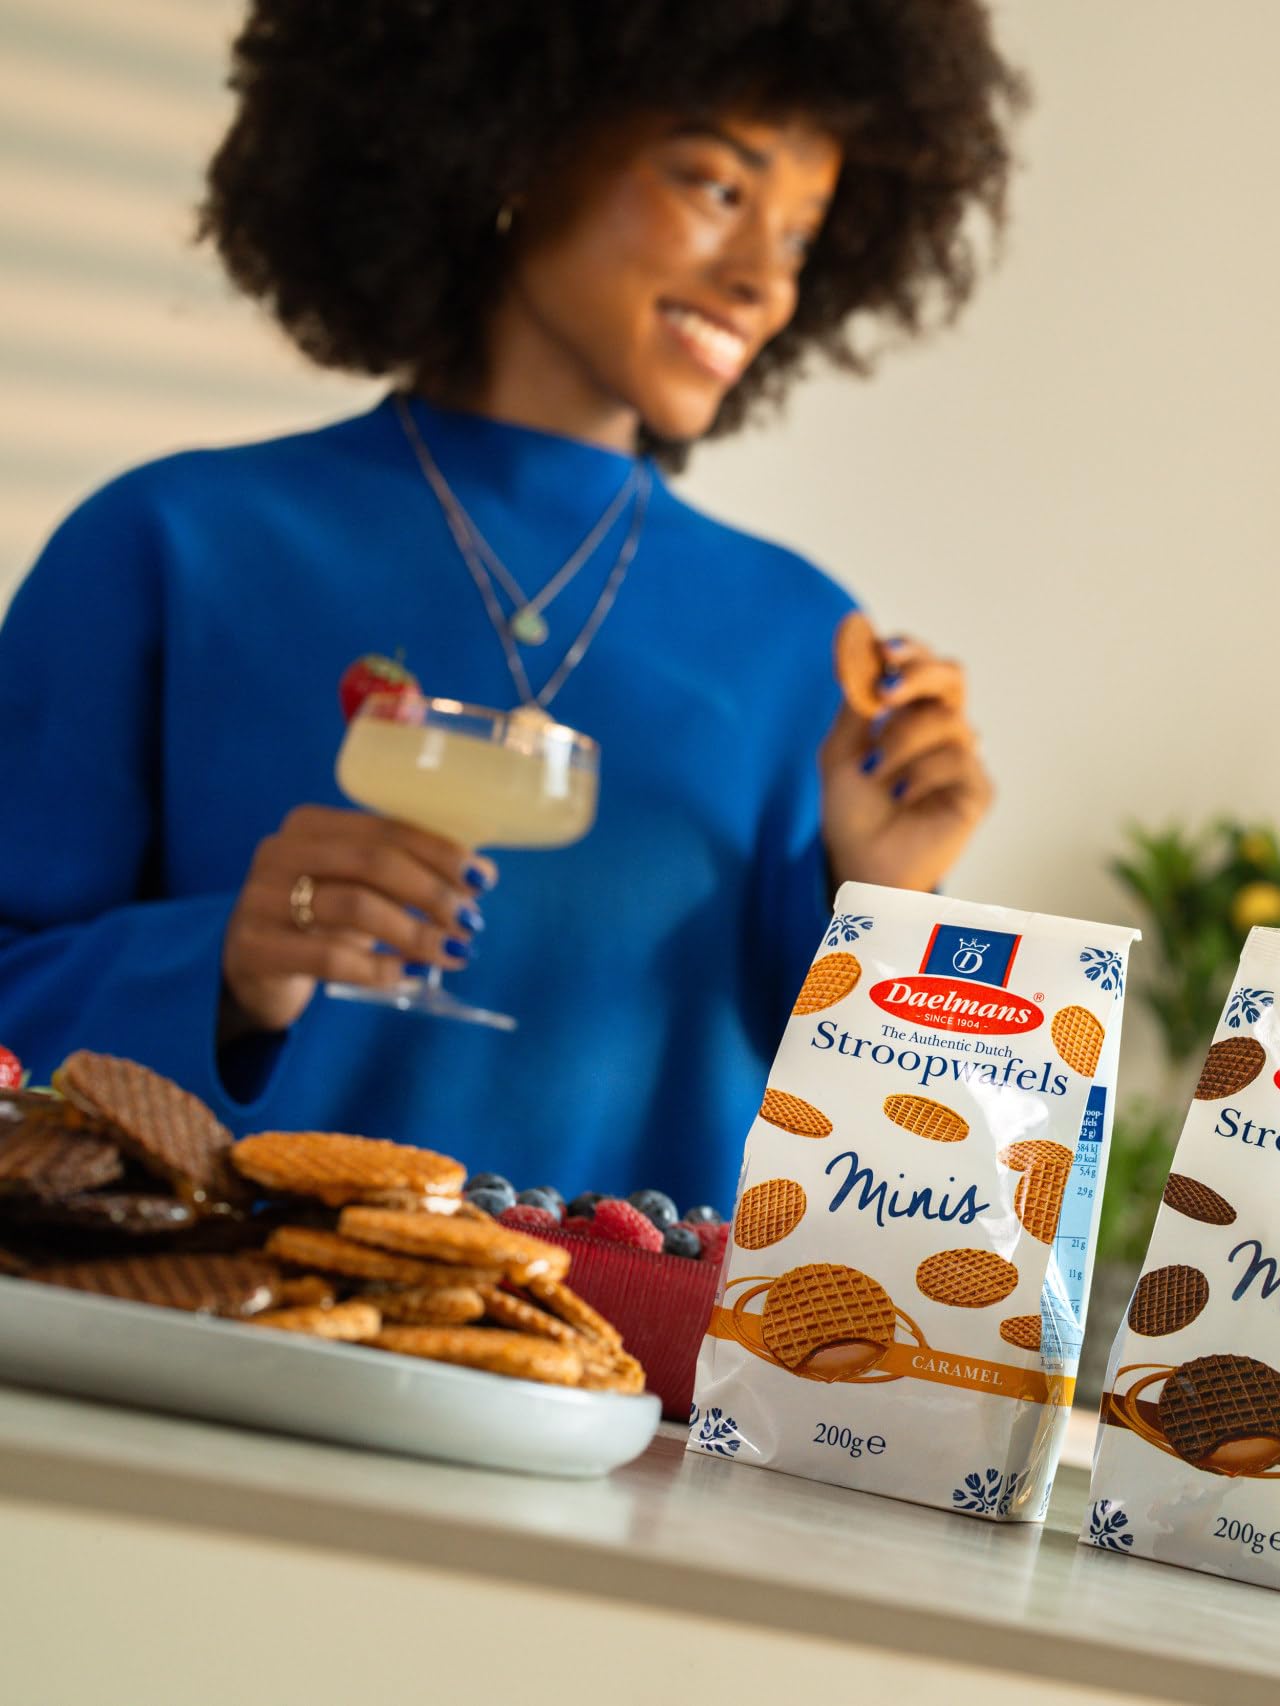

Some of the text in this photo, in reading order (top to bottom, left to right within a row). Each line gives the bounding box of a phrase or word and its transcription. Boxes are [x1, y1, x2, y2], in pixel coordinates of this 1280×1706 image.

[883, 983, 1032, 1024] Daelmans
[924, 1013, 980, 1029] SINCE 1904
[810, 1020, 1069, 1097] Stroopwafels
[881, 1024, 1013, 1058] The Authentic Dutch
[825, 1151, 990, 1227] Minis
[911, 1354, 1003, 1386] CARAMEL
